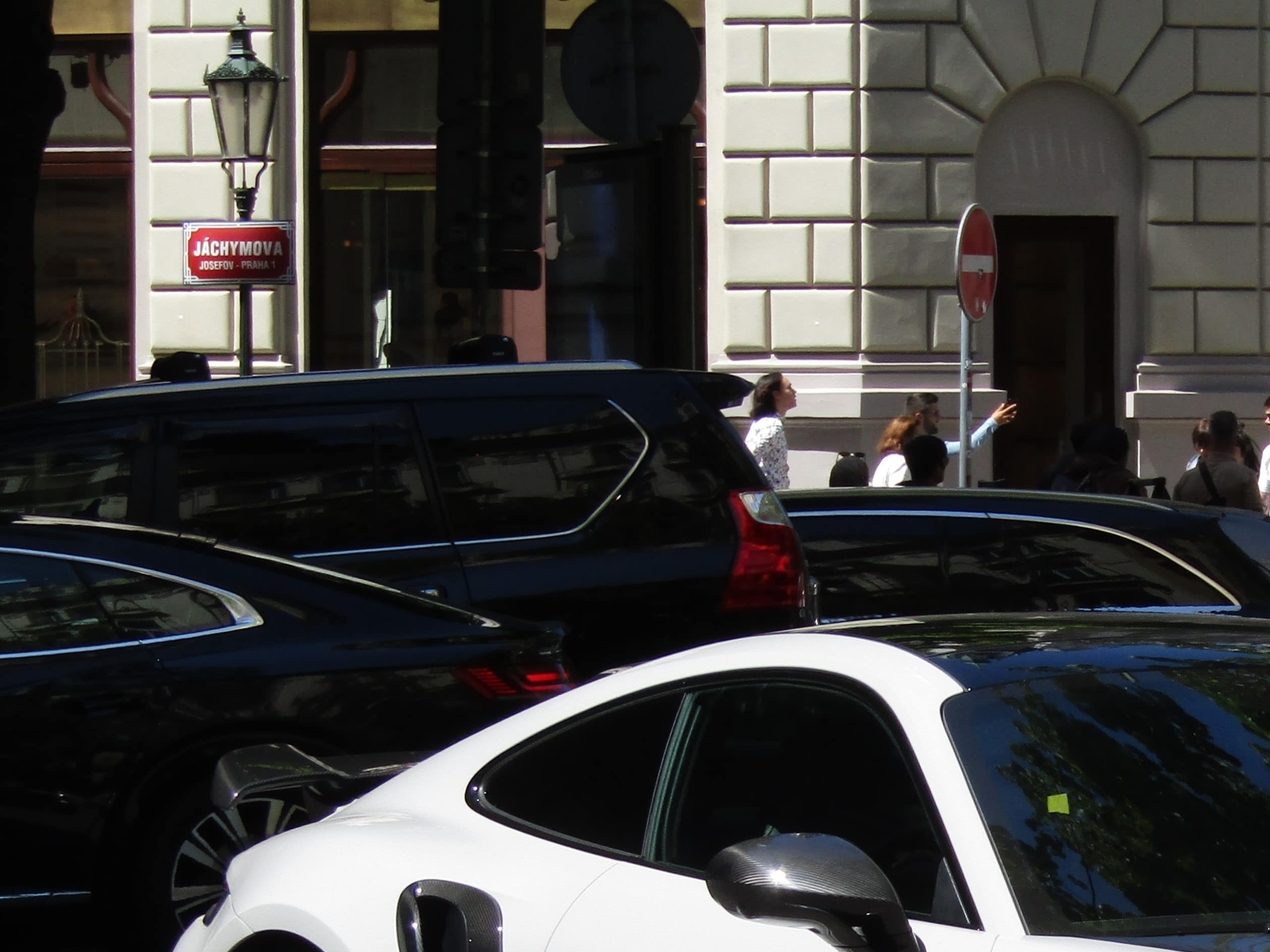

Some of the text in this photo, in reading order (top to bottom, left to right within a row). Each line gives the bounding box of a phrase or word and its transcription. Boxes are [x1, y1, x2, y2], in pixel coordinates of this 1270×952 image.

[194, 237, 283, 256] JÁCHYMOVA
[199, 260, 234, 270] JOSEFOV
[241, 261, 270, 270] PRAHA
[272, 261, 276, 270] 1
